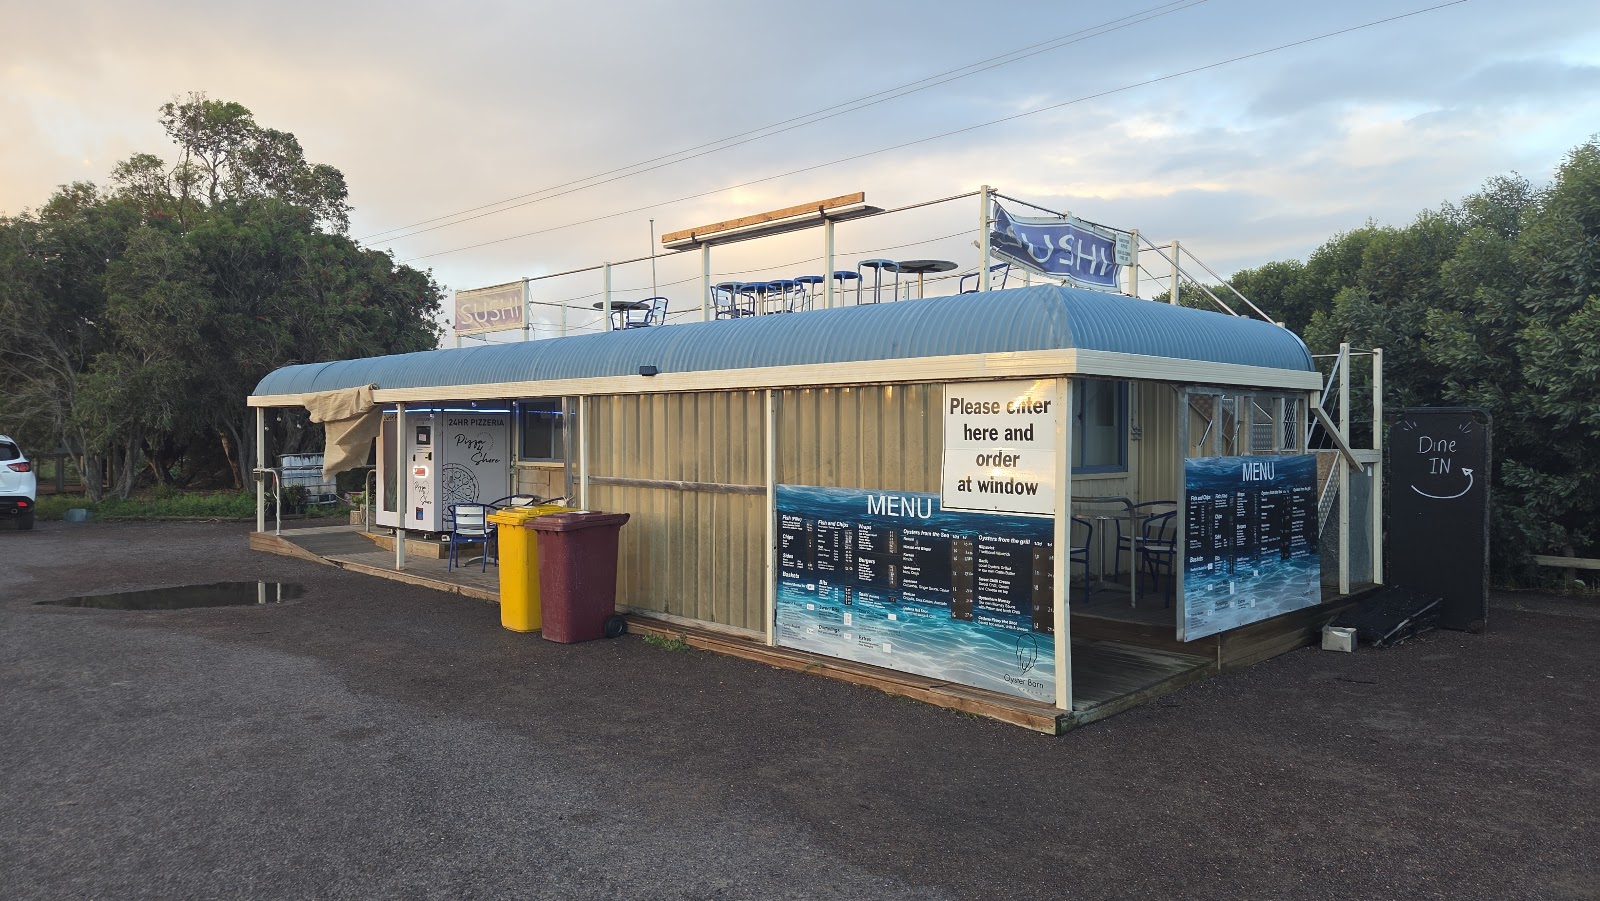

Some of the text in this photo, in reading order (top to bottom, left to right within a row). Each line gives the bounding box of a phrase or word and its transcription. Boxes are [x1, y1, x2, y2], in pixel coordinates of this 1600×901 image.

[461, 296, 519, 325] SUSHI
[950, 397, 1051, 415] Please enter
[449, 418, 504, 426] 24HR PIZZERIA
[454, 433, 486, 449] Pizza
[964, 423, 1034, 441] here and
[1417, 435, 1457, 454] Dine
[975, 450, 1020, 468] order
[1429, 457, 1451, 475] IN
[1242, 462, 1275, 481] MENU
[957, 476, 1039, 496] at window
[868, 495, 932, 518] MENU
[1003, 673, 1044, 689] Oyster Barn
